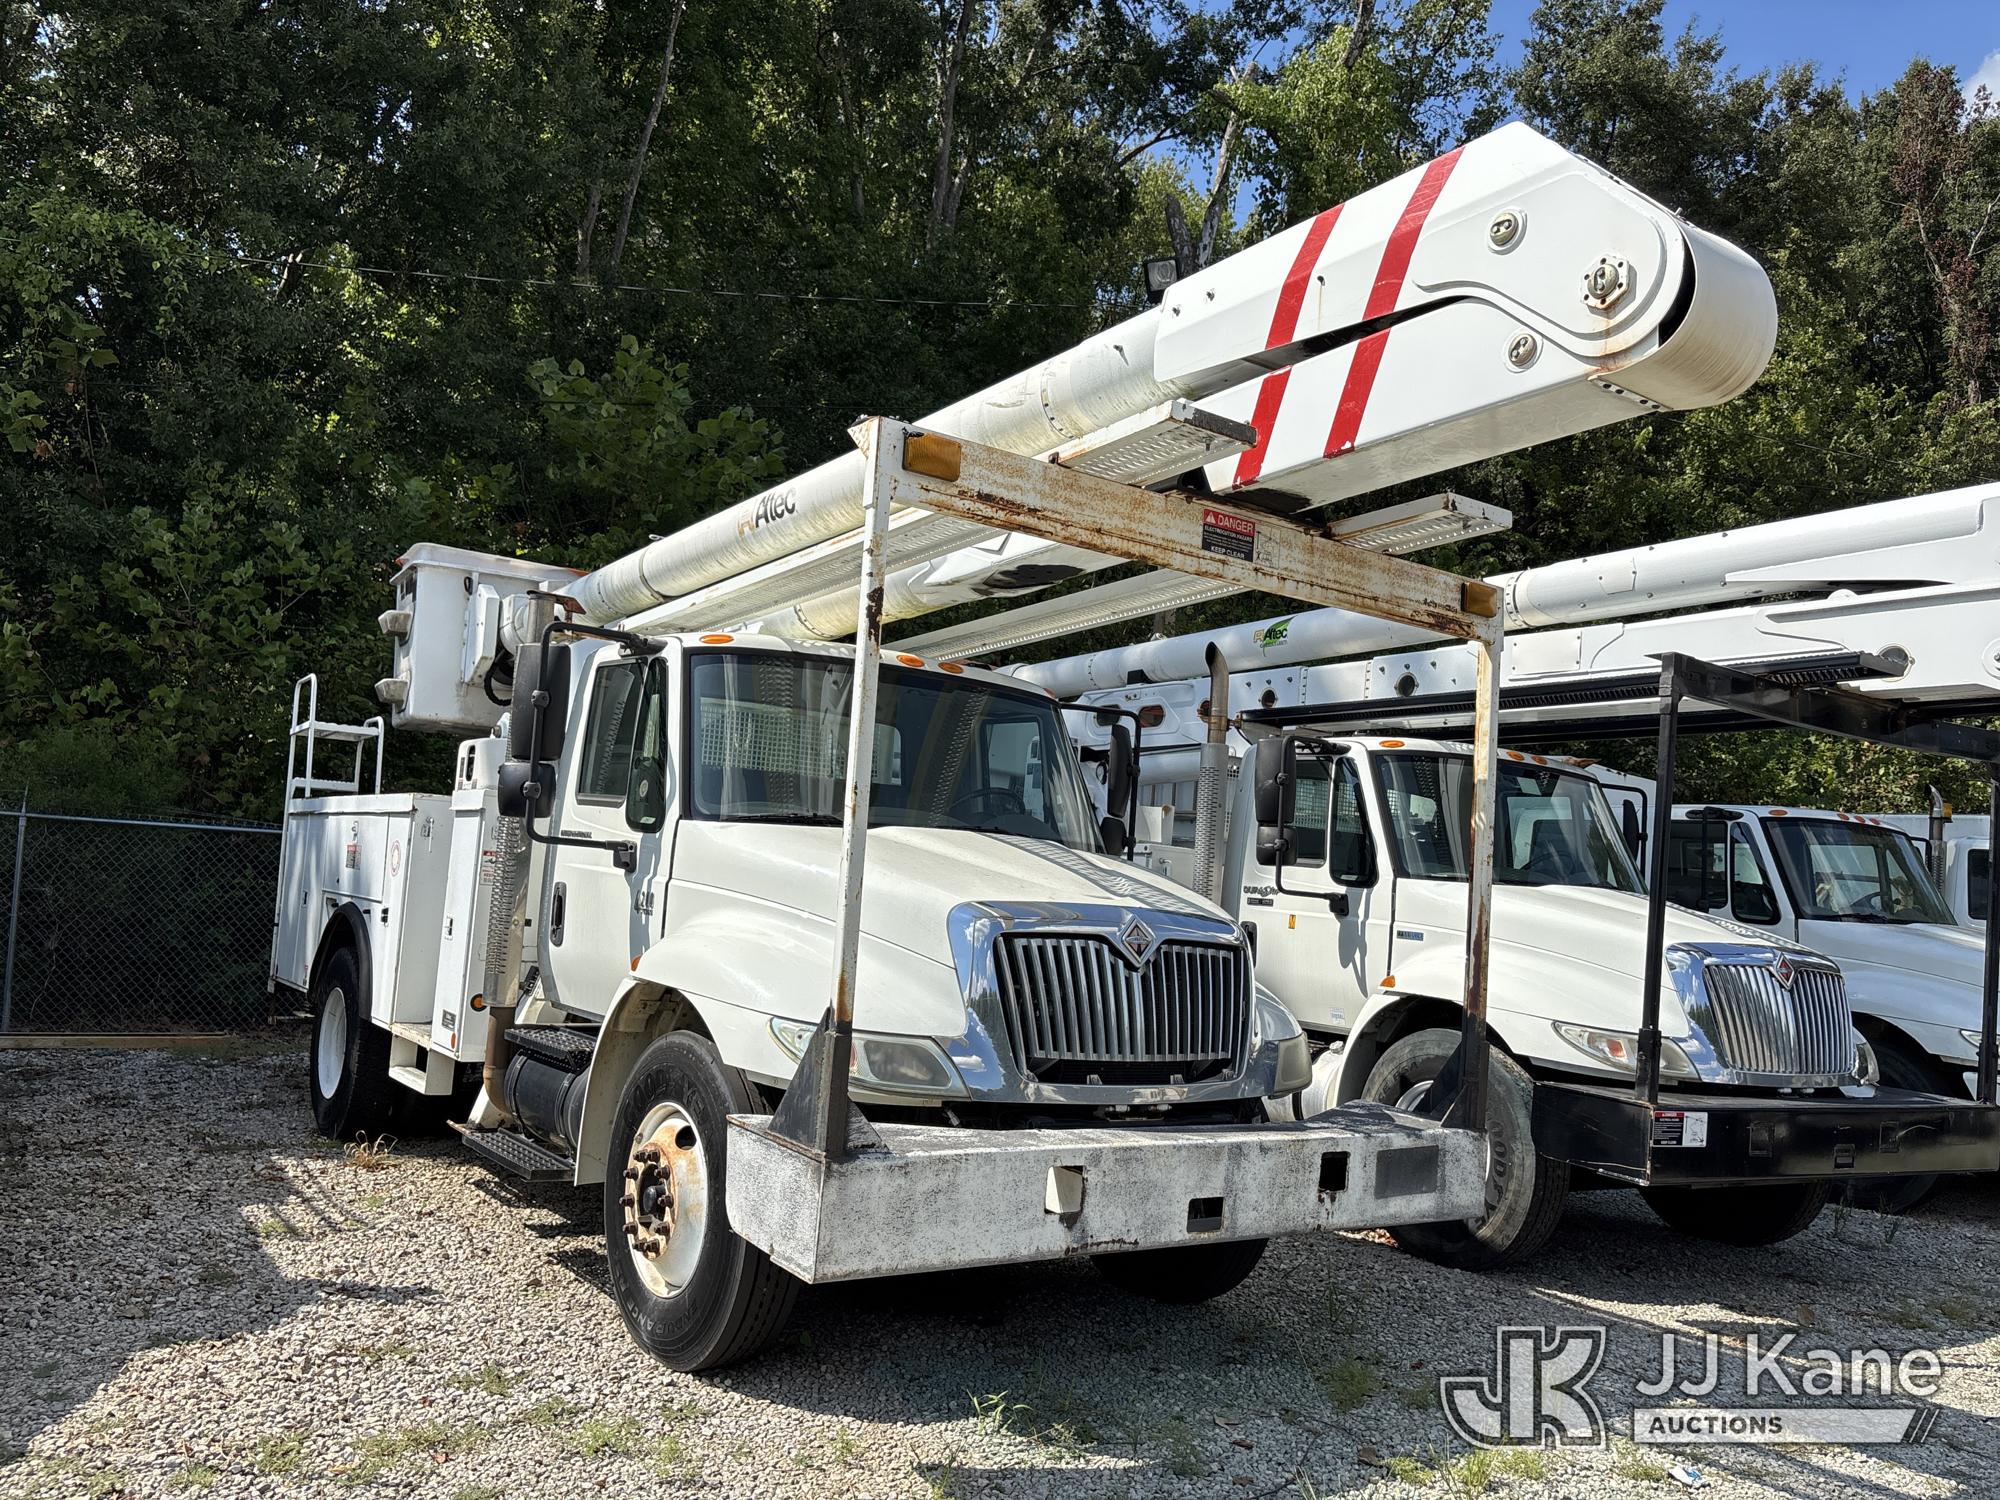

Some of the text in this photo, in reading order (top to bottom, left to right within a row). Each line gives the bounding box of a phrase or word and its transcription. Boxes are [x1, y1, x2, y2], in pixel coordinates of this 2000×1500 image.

[1217, 515, 1254, 533] DANGER
[1211, 546, 1245, 560] KEEP CLEAR
